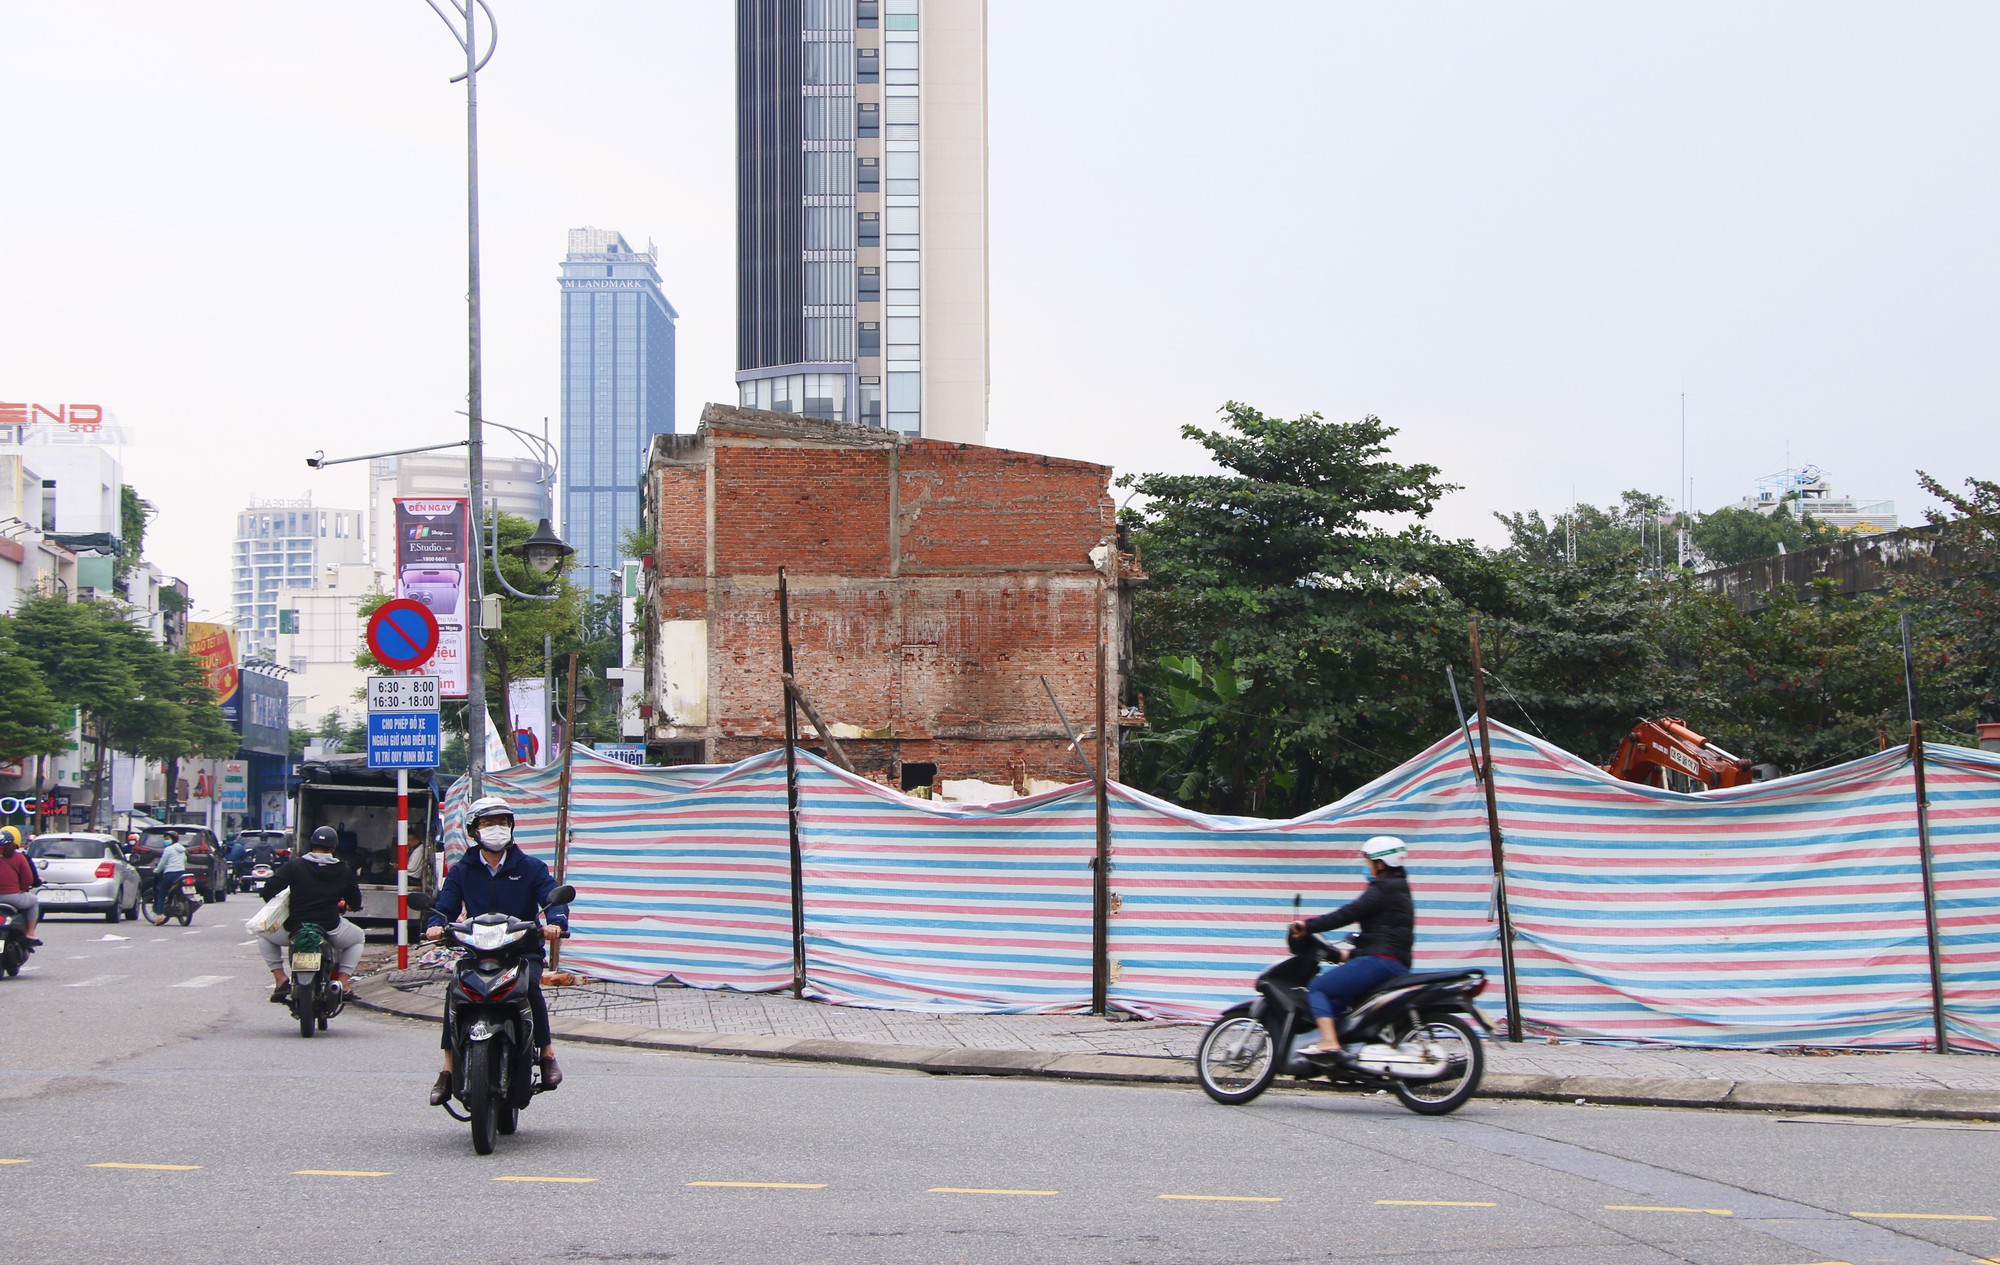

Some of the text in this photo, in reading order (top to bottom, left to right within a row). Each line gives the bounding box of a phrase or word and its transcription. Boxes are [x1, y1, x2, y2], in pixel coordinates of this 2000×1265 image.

[565, 279, 642, 288] M LANDMARK
[69, 424, 103, 433] SHOP
[408, 502, 452, 512] ĐẾN NGAY
[378, 681, 399, 693] 6:30
[413, 681, 434, 693] 8:00
[373, 696, 399, 708] 16:30
[408, 695, 434, 707] 18:00
[381, 718, 394, 730] CHO
[394, 716, 408, 730] PHÉP
[418, 718, 426, 730] XE
[372, 732, 389, 747] NGOÀI
[389, 731, 400, 746] GIỜ
[400, 734, 411, 746] CAO
[427, 734, 437, 748] TẠI
[374, 751, 381, 765] VỊ
[381, 749, 391, 763] TRÍ
[391, 751, 402, 764] QUY
[402, 751, 417, 765] ĐỊNH
[426, 751, 434, 762] XE
